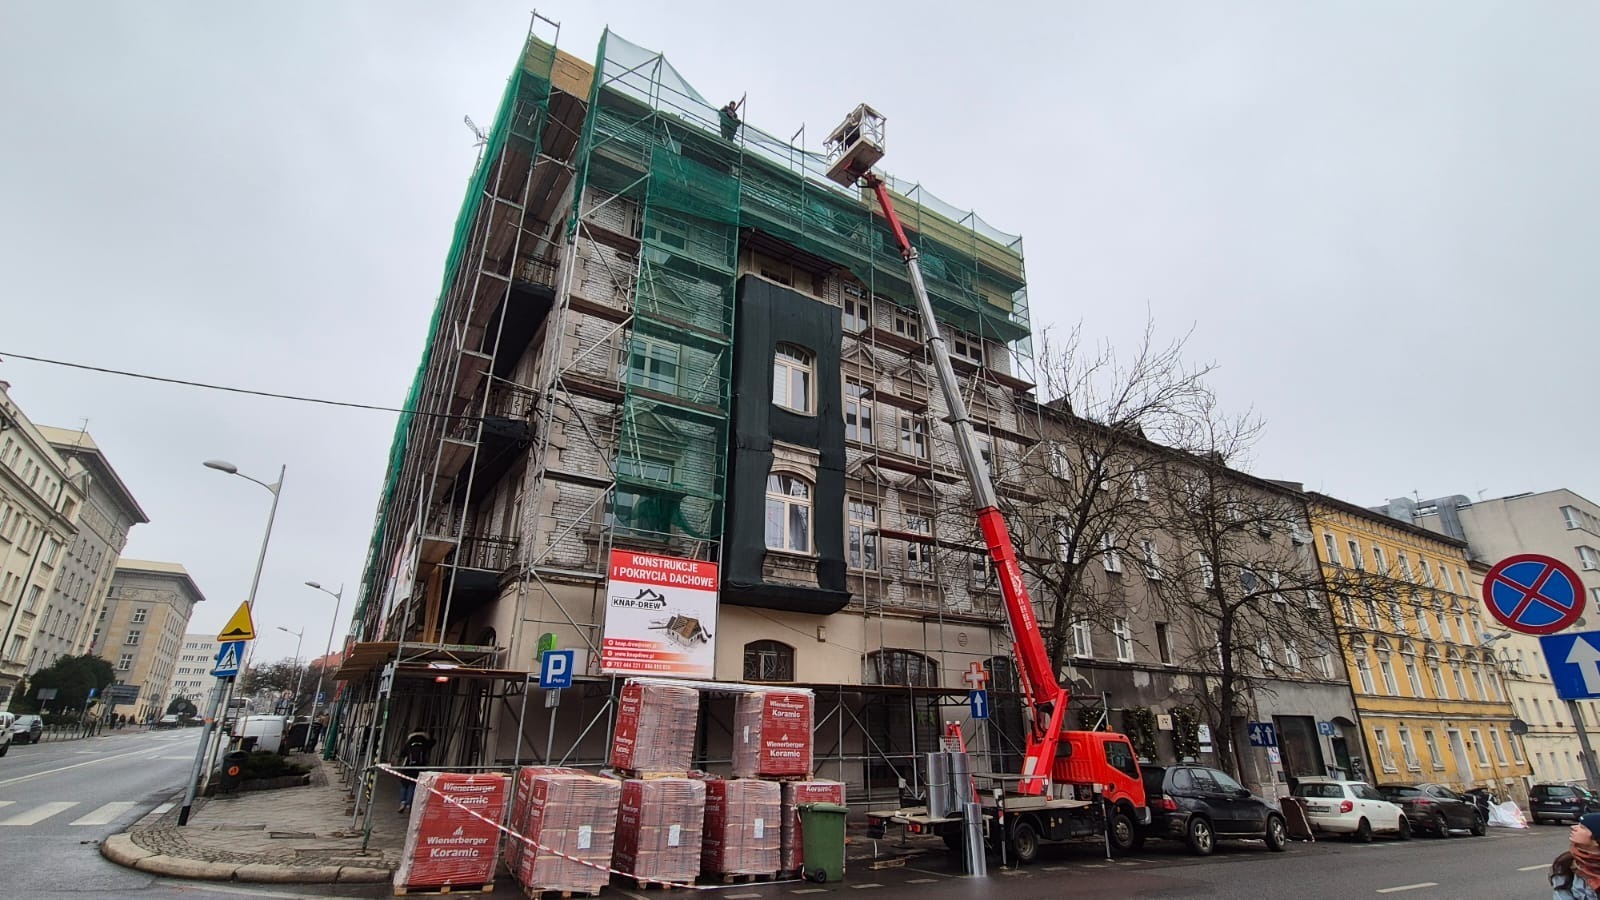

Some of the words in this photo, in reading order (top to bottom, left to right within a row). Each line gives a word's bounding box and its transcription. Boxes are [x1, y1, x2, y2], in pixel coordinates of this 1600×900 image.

[632, 555, 698, 573] KONSTRUKCJE
[613, 566, 617, 576] I
[620, 567, 668, 582] POKRYCIA
[670, 572, 714, 588] DACHOWE
[613, 598, 661, 610] KNAP-DREW
[546, 654, 567, 684] P
[769, 700, 804, 710] Wienerberger
[772, 709, 801, 718] Koramic
[766, 740, 805, 749] Wienerberger
[770, 749, 801, 758] Koramic
[443, 782, 496, 793] Wienerberger
[427, 836, 489, 846] Wienerberger
[430, 848, 479, 858] Koramic
